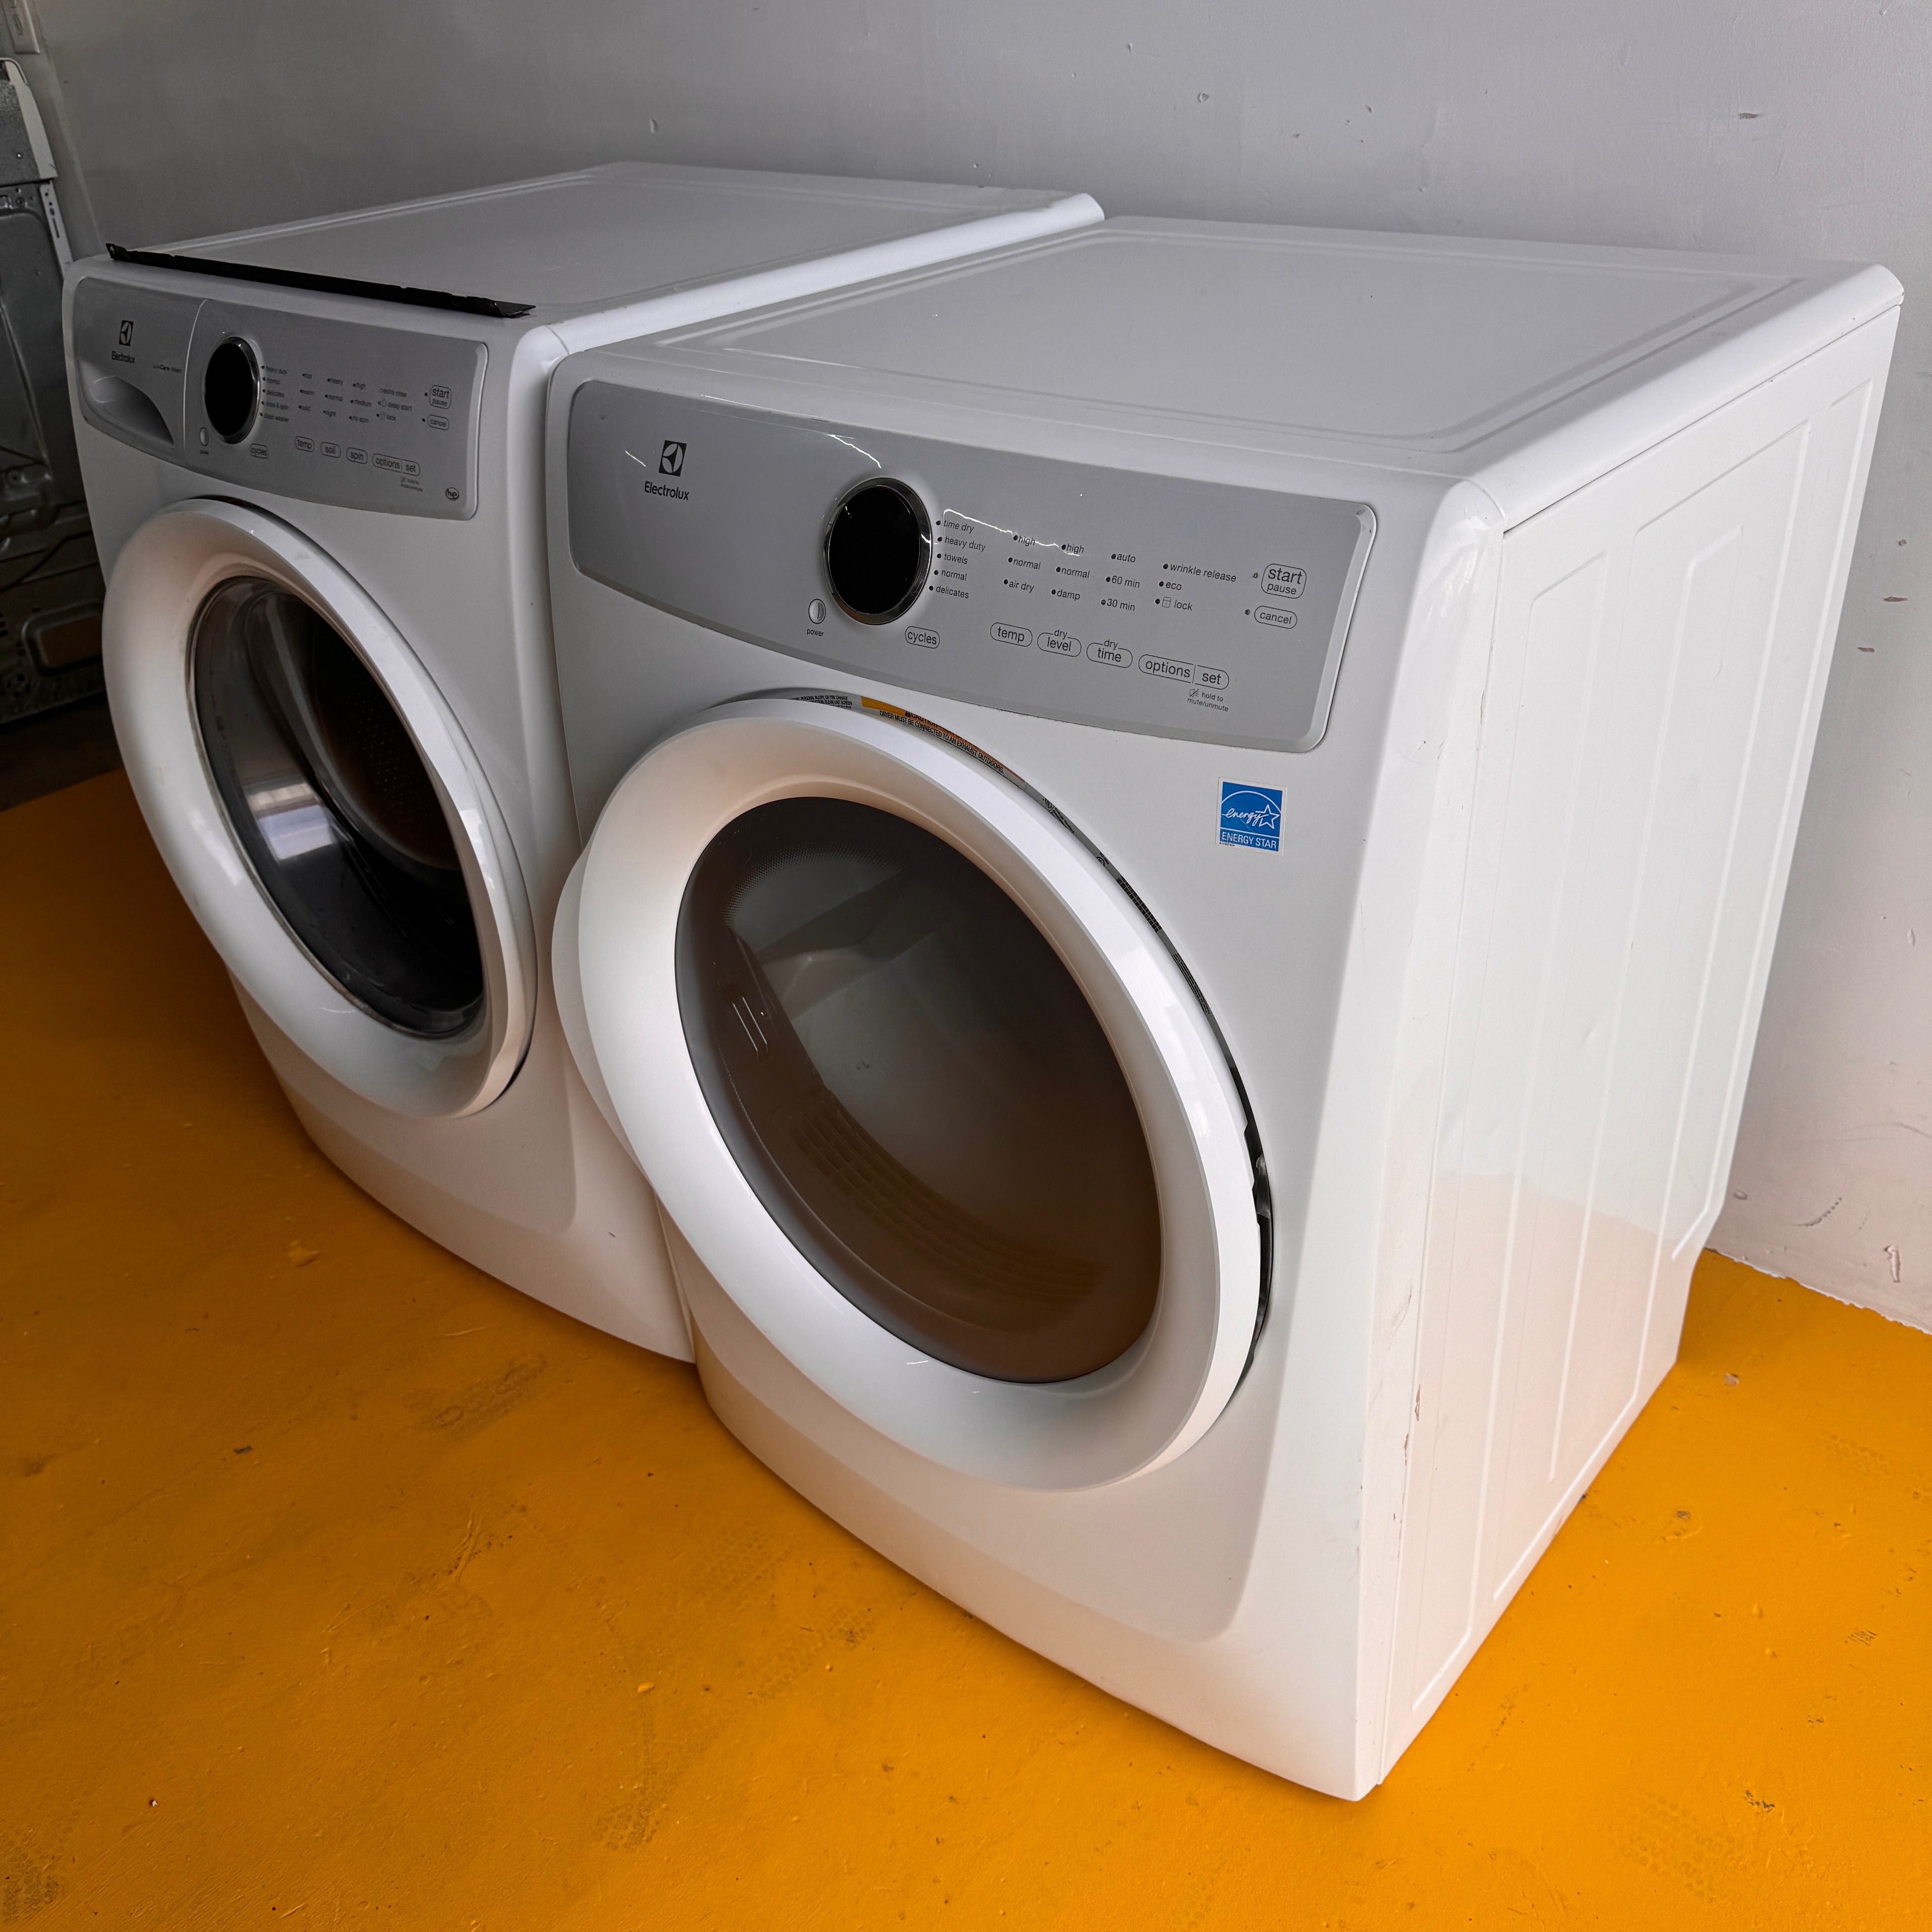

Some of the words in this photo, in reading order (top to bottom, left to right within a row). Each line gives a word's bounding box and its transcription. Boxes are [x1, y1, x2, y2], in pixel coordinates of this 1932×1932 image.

[112, 351, 135, 363] Electrolux
[432, 388, 449, 399] start
[297, 439, 312, 449] temp
[252, 447, 267, 456] cycles
[325, 446, 336, 455] soil
[350, 452, 363, 461] spin
[376, 457, 400, 469] options
[405, 463, 416, 473] set
[644, 481, 690, 501] Electrolux
[943, 520, 960, 529] time
[961, 524, 974, 534] dry
[945, 536, 967, 549] heavy
[969, 542, 986, 552] duty
[1018, 535, 1035, 547] high
[1067, 543, 1084, 554] high
[944, 553, 968, 564] towels
[1013, 559, 1041, 569] normal
[1116, 553, 1136, 563] auto
[941, 570, 967, 580] normal
[1061, 568, 1090, 578] normal
[1170, 563, 1201, 575] wrinkle
[1203, 570, 1237, 582] release
[1268, 567, 1302, 584] start
[1009, 580, 1019, 589] air
[1021, 582, 1034, 593] dry
[1112, 575, 1122, 584] 60
[1124, 578, 1140, 588] min
[1166, 582, 1182, 590] eco
[936, 585, 969, 598] delicates
[1267, 583, 1297, 594] pause
[1057, 589, 1080, 601] damp
[1107, 598, 1118, 607] 30
[1120, 601, 1136, 611] min
[1174, 599, 1193, 611] lock
[1260, 612, 1292, 625] cancel
[806, 628, 824, 637] power
[907, 631, 937, 645] cycles
[998, 626, 1025, 644] temp
[1054, 629, 1067, 639] dry
[1047, 637, 1072, 652] level
[1104, 639, 1118, 650] dry
[1097, 648, 1122, 662] time
[1145, 661, 1191, 678] options
[1202, 672, 1221, 685] set
[1202, 692, 1215, 700] hold
[1187, 698, 1228, 712] mute/unmute
[879, 710, 894, 719] DRYER
[894, 714, 907, 723] MUST
[915, 721, 942, 737] CONNECTED
[957, 741, 978, 756] EXHAUST
[978, 753, 1004, 774] OUTDOORS.
[1224, 808, 1265, 826] energy
[1222, 831, 1254, 845] ENERGY
[1256, 837, 1276, 849] STAR
